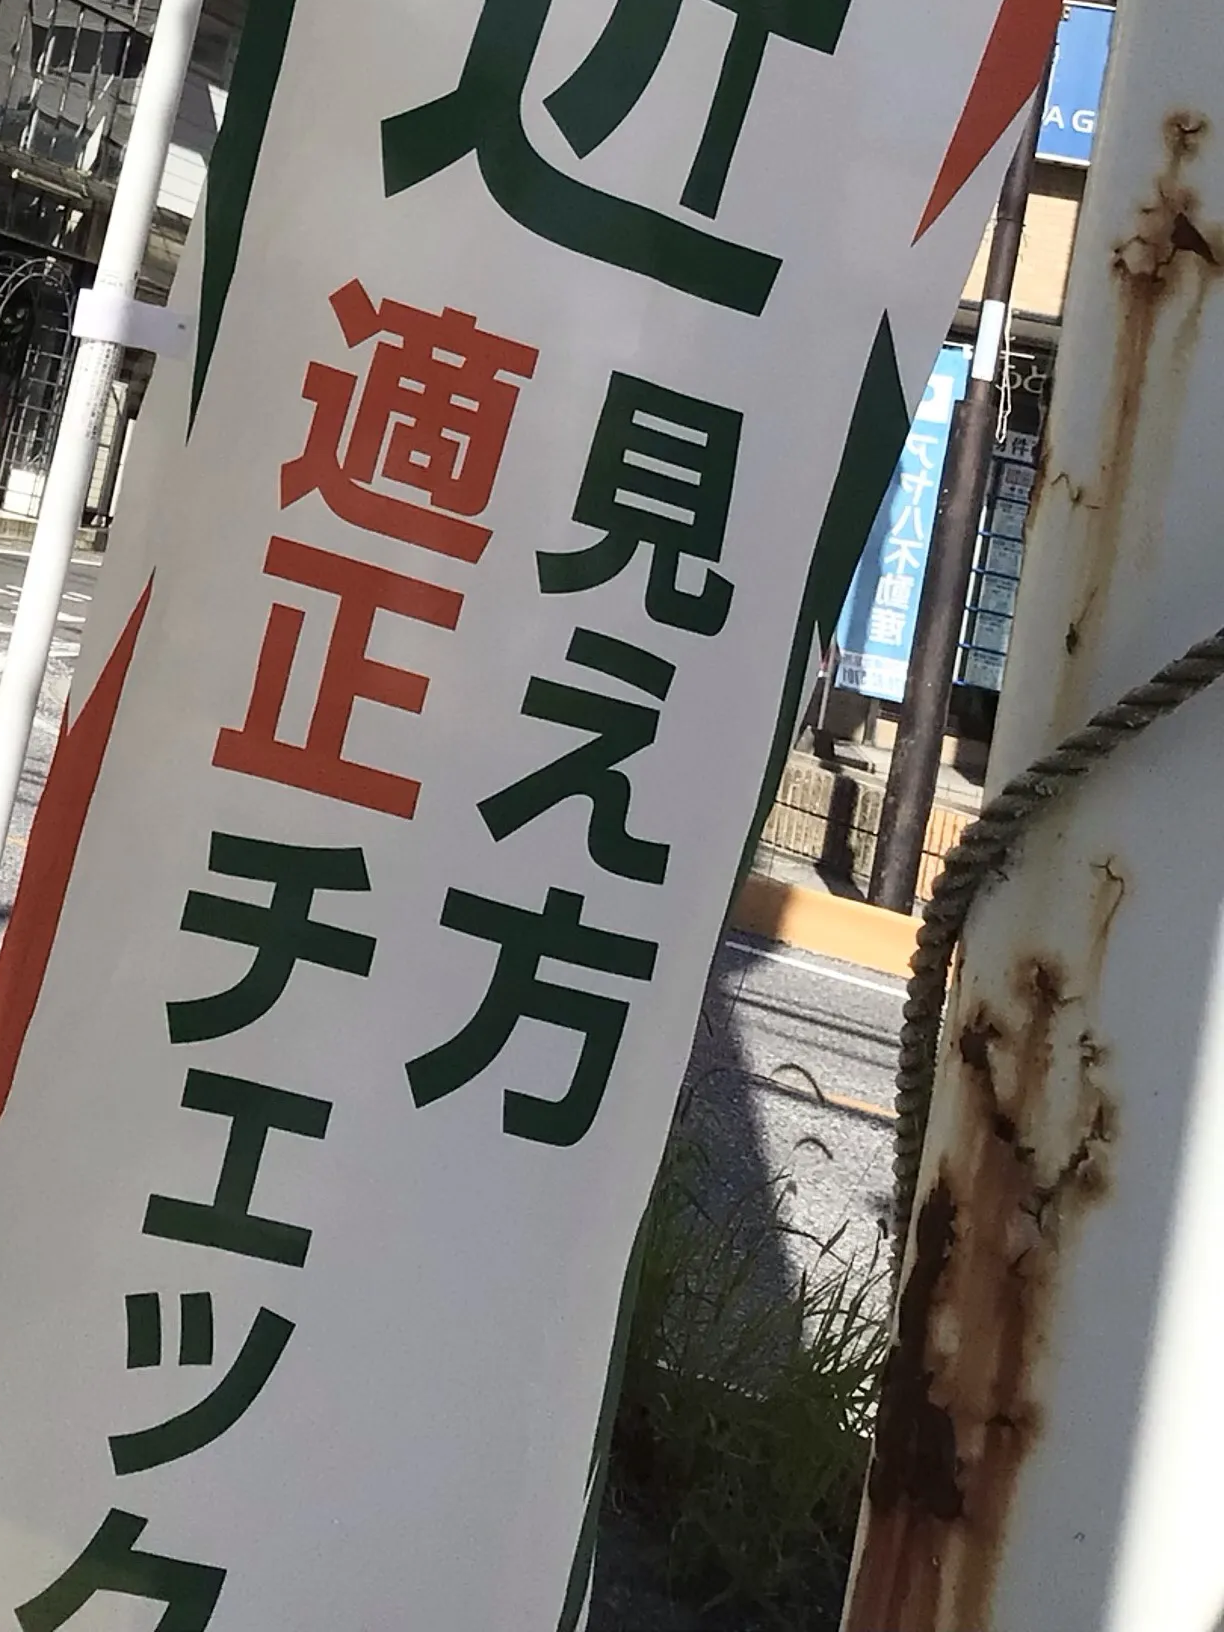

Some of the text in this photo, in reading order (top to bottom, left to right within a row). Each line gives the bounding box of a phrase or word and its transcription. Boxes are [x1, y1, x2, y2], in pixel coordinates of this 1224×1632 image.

[13, 278, 539, 1632] 適正チェック
[405, 370, 744, 1147] 見え方
